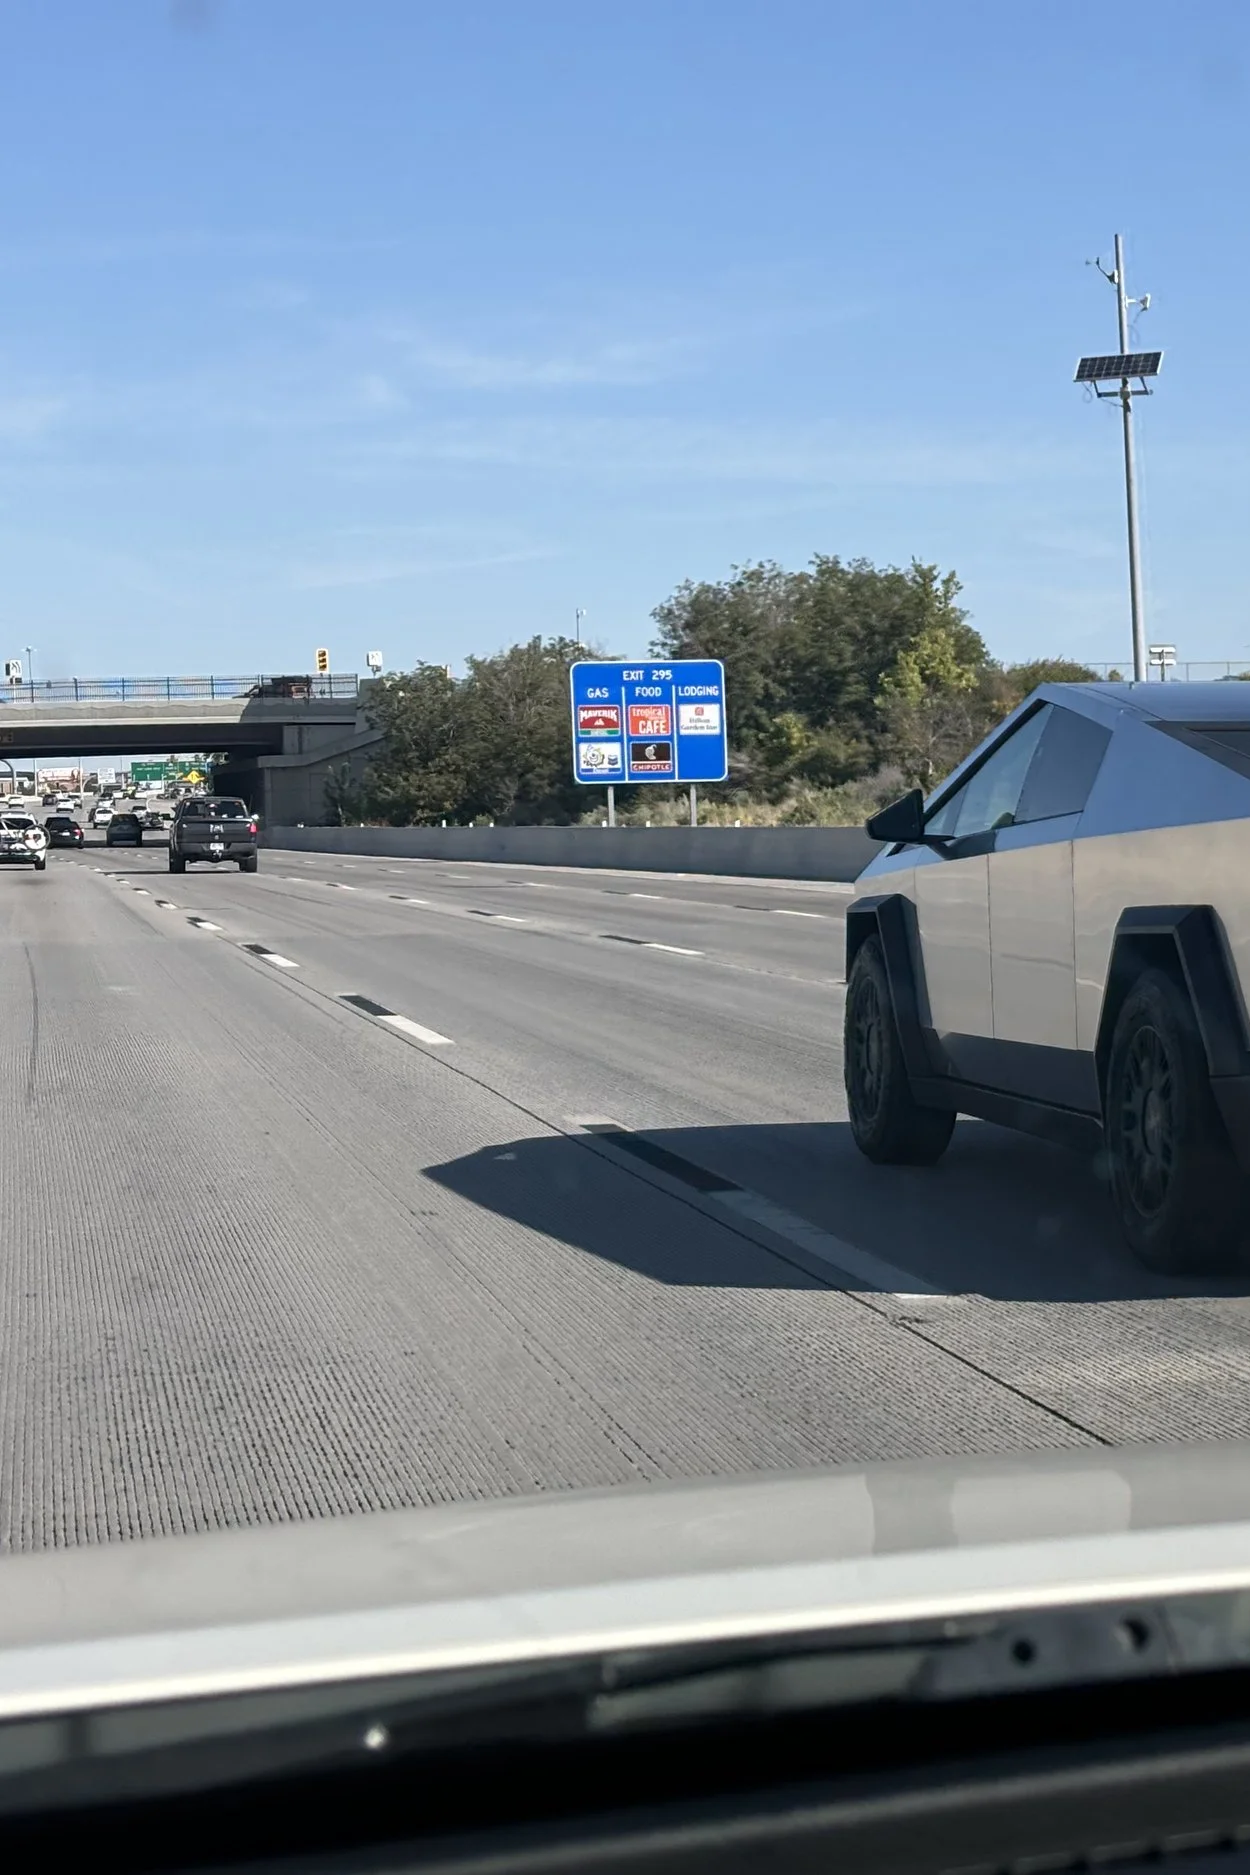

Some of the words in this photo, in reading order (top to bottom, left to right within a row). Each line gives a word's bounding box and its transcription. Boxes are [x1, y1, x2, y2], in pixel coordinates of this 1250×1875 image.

[622, 670, 645, 681] EXIT
[651, 669, 673, 680] 295
[586, 687, 609, 698] GAS
[635, 686, 662, 697] FOOD
[678, 686, 719, 697] LODGING
[580, 709, 618, 723] MAVERIK
[632, 706, 666, 718] tropical
[638, 720, 668, 734] CAFE
